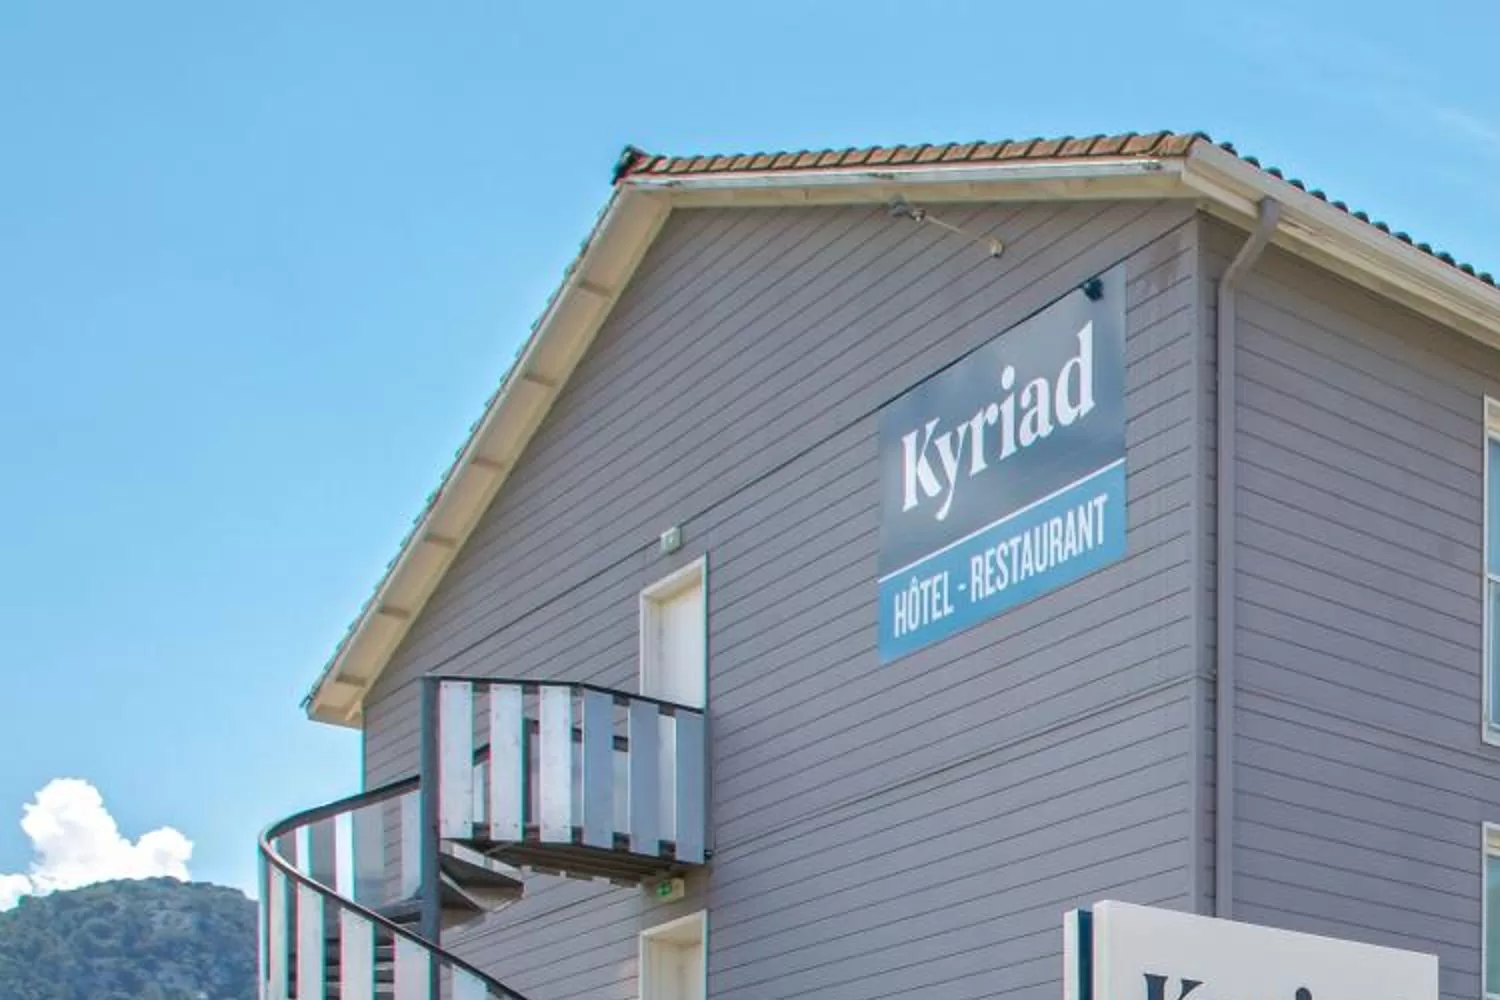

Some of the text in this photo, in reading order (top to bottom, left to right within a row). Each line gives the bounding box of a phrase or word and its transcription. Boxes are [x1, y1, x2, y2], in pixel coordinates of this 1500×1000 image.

[902, 320, 1096, 521] Kyriad
[894, 571, 954, 639] HÔTEL
[970, 493, 1108, 603] RESTAURANT
